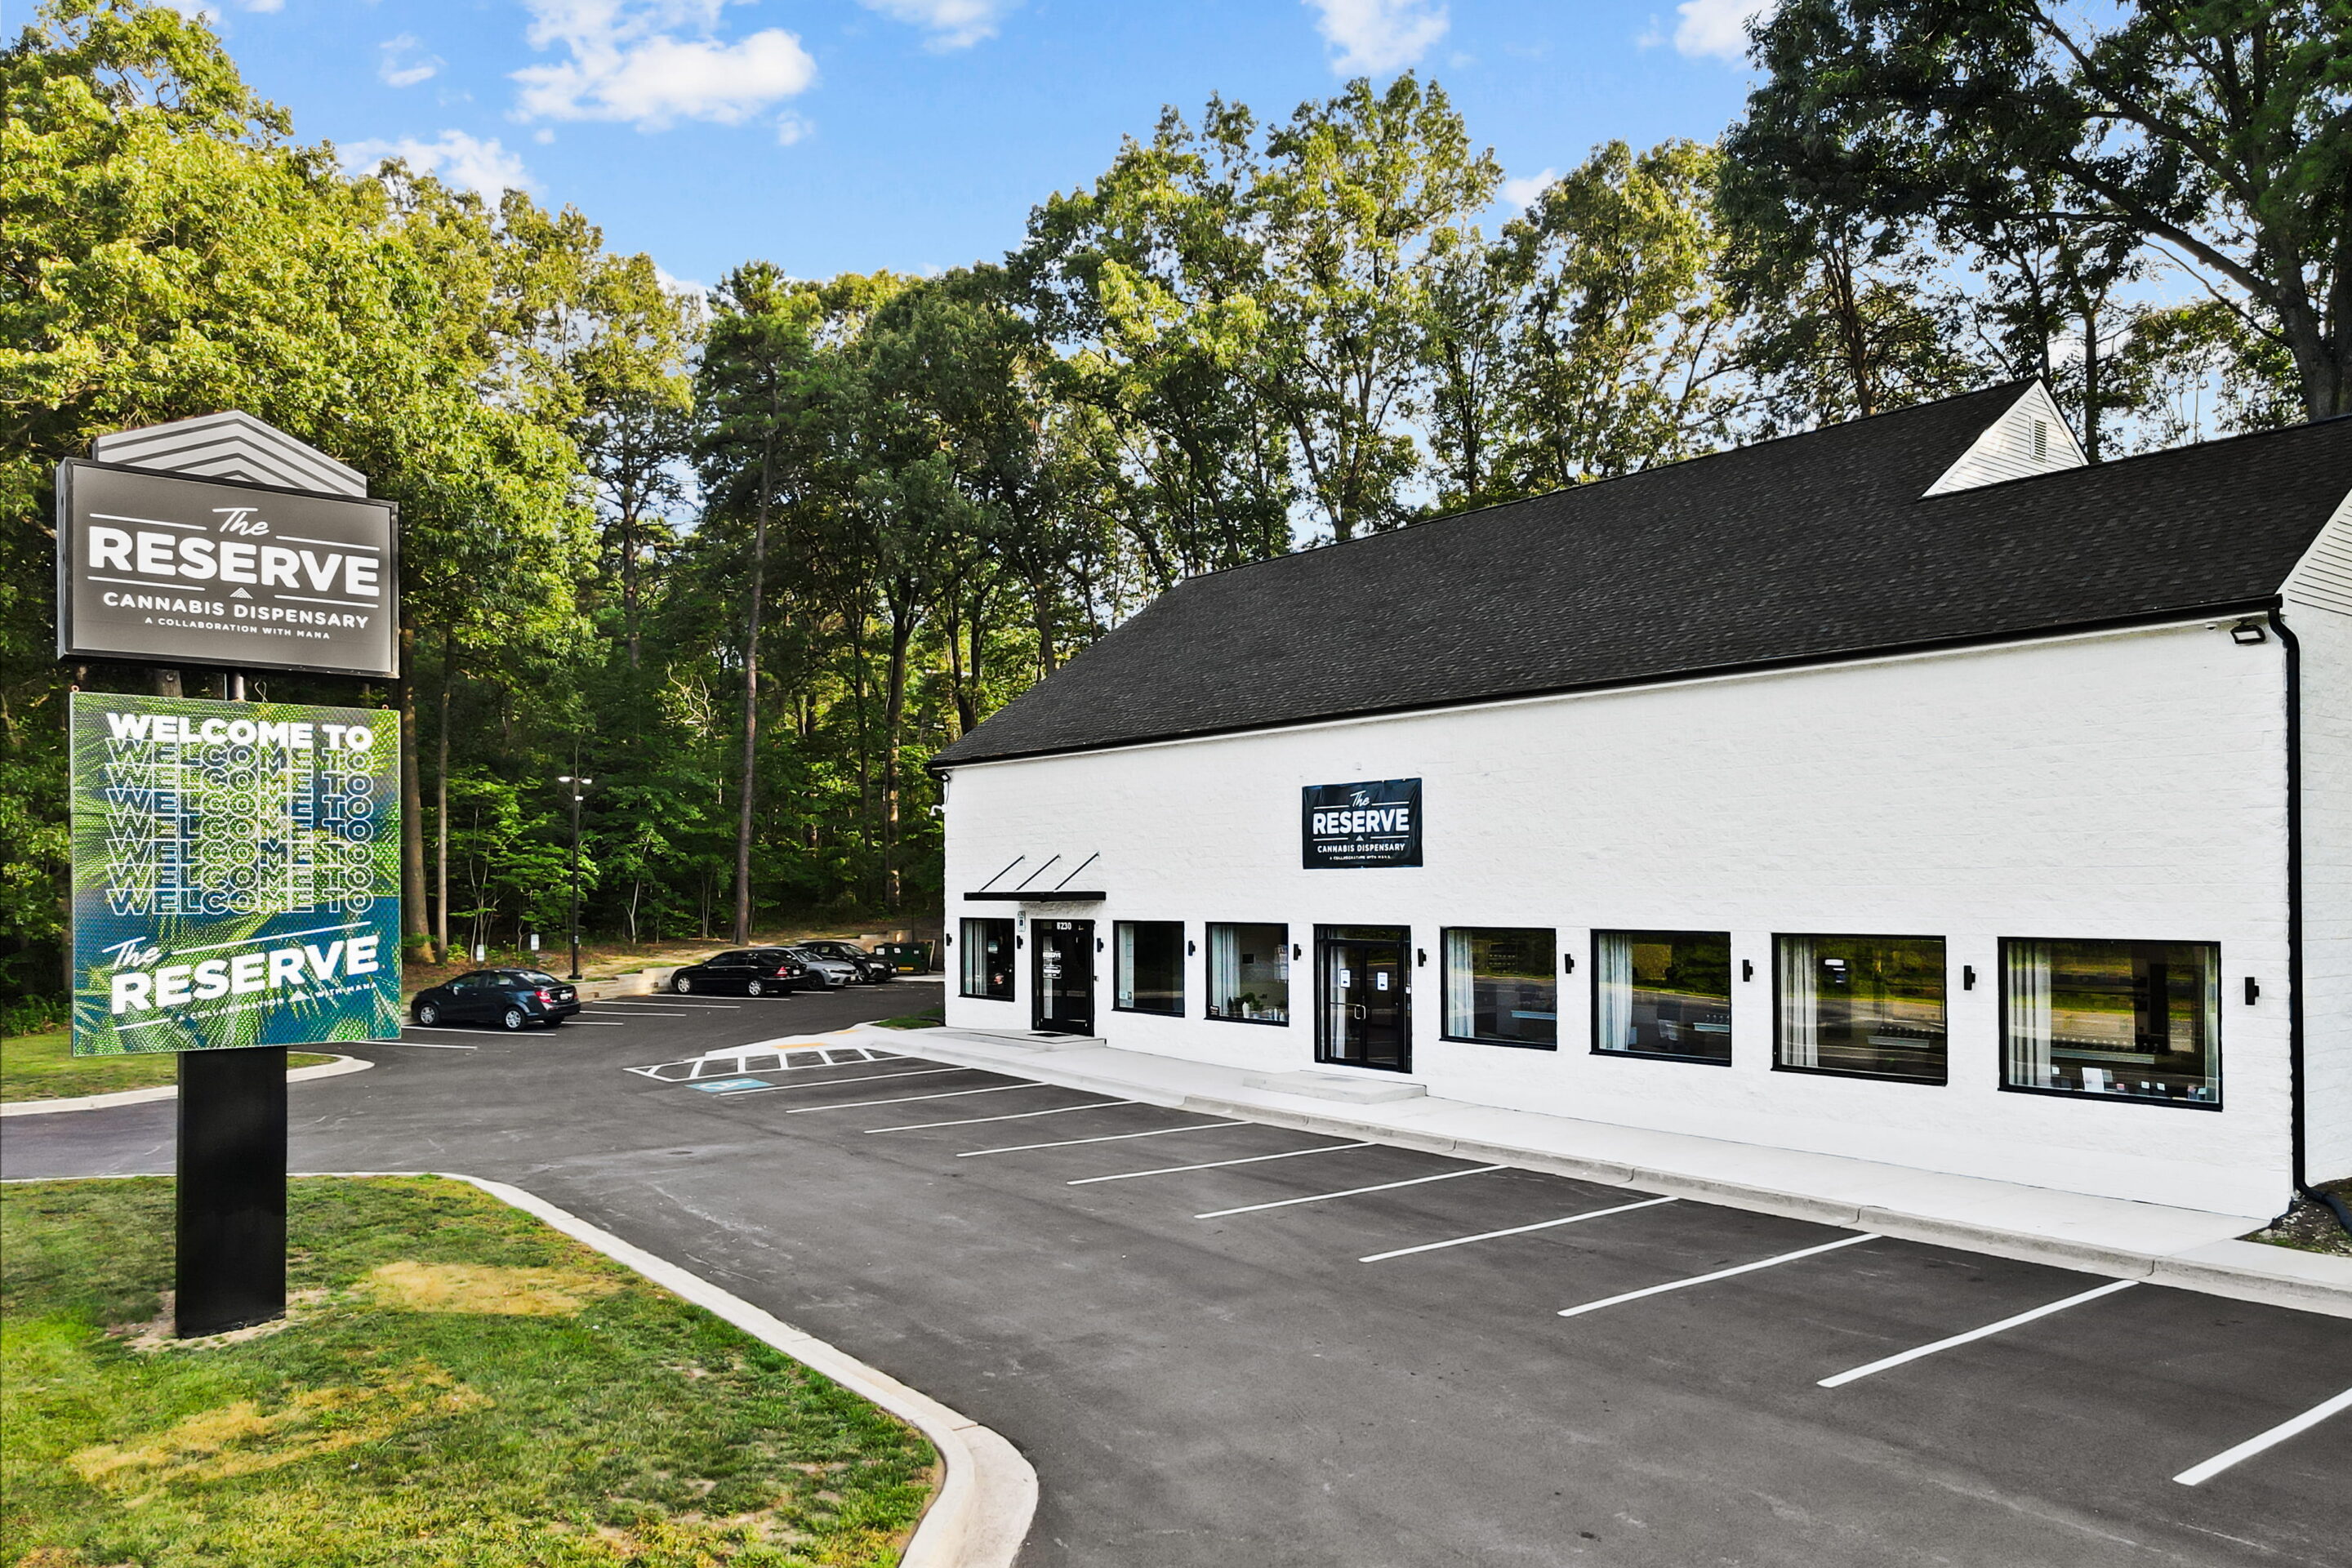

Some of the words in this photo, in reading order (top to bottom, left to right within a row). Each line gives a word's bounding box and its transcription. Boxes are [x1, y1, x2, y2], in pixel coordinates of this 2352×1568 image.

[212, 506, 270, 537] The
[88, 525, 380, 597] RESERVE
[102, 591, 225, 617] CANNABIS
[233, 604, 369, 630] DISPENSARY
[145, 617, 154, 625] A
[158, 617, 257, 634] COLLABORATION
[262, 626, 292, 637] WITH
[296, 630, 331, 640] MANA
[105, 711, 314, 748] WELCOME
[322, 724, 374, 751] TO
[105, 737, 314, 770] WELCOME
[322, 747, 374, 773] TO
[105, 762, 314, 794] WELCOME
[322, 771, 374, 796] TO
[105, 788, 314, 818] WELCOME
[322, 795, 374, 819] TO
[1349, 790, 1370, 808] The
[105, 813, 314, 843] WELCOME
[322, 818, 374, 843] TO
[1312, 808, 1410, 835] RESERVE
[105, 838, 314, 866] WELCOME
[322, 841, 374, 866] TO
[1316, 844, 1355, 853] CANNABIS
[1356, 843, 1405, 853] DISPENSARY
[105, 863, 314, 890] WELCOME
[322, 865, 374, 890] TO
[105, 888, 314, 915] WELCOME
[322, 888, 374, 914] TO
[102, 936, 163, 970] The
[111, 934, 380, 1015] RESERVE
[350, 982, 378, 995] MANA
